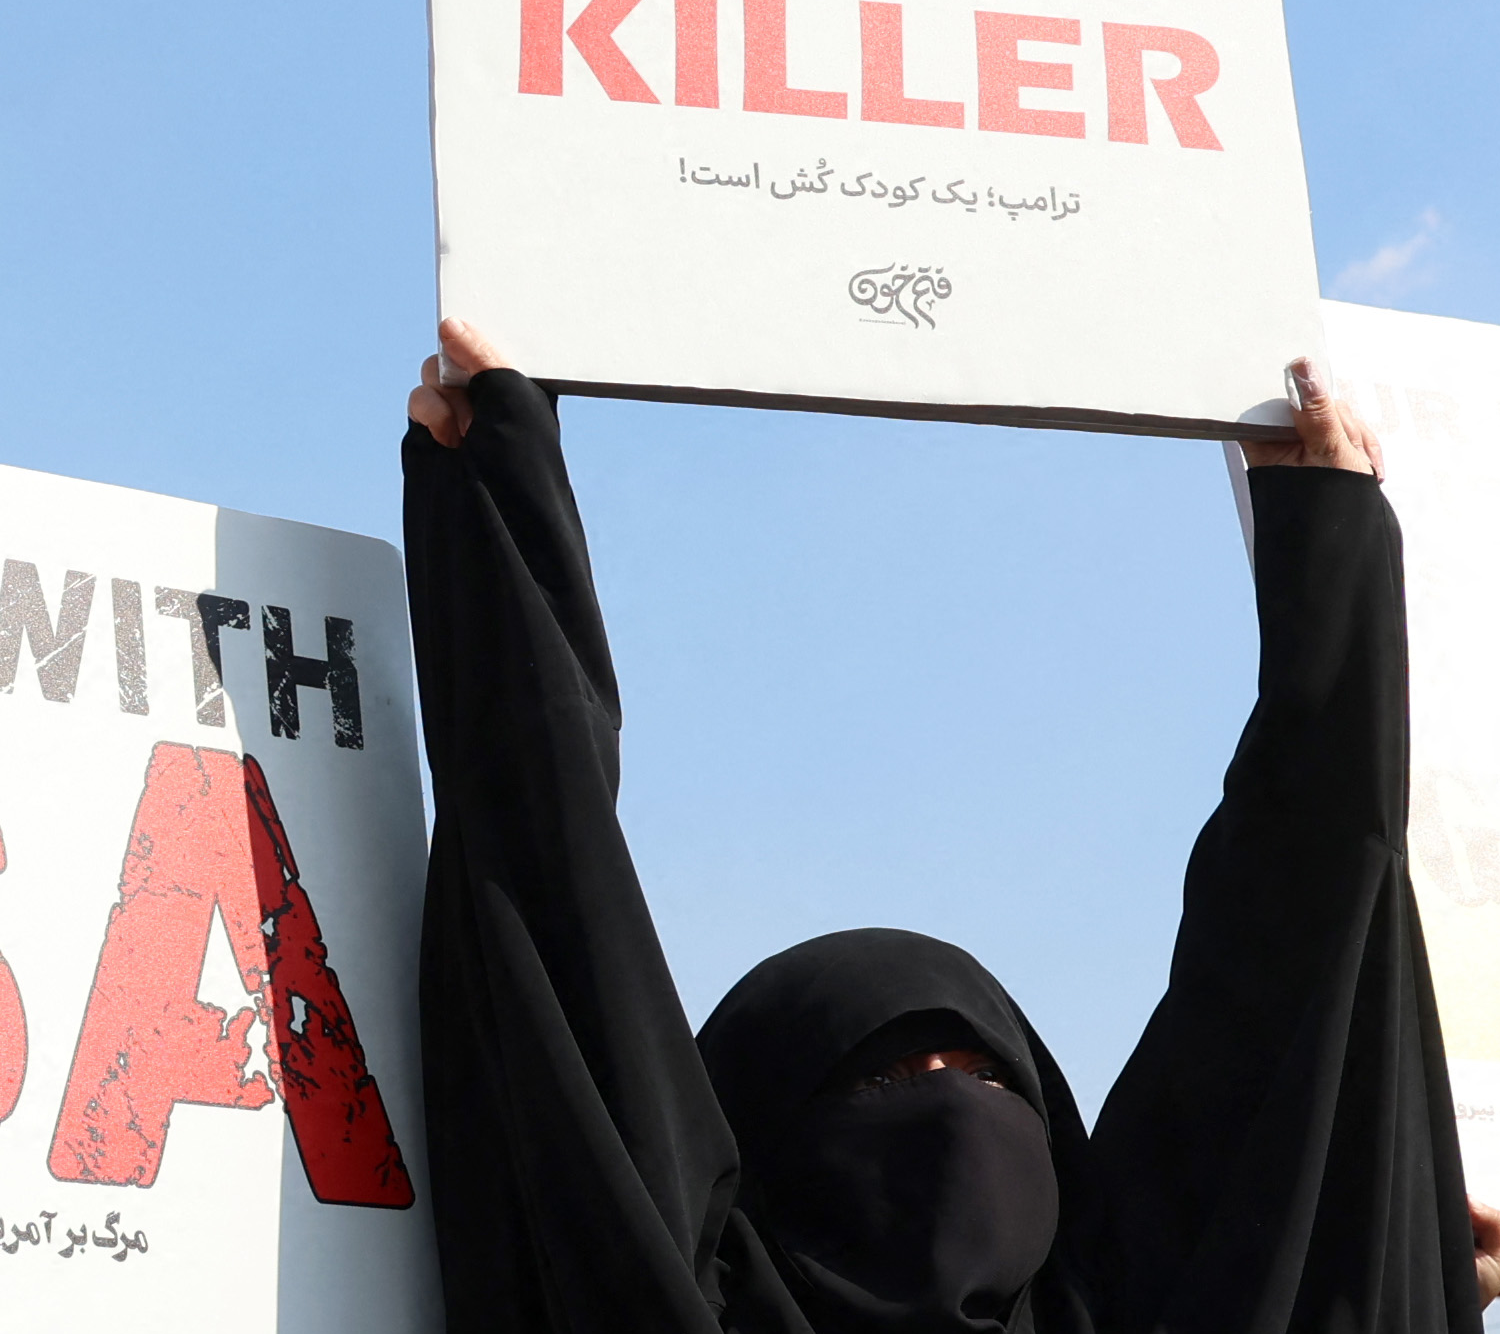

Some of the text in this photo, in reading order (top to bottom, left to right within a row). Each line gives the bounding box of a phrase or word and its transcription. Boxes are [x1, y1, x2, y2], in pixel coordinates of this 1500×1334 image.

[680, 158, 760, 188] است!
[841, 173, 925, 208] کودک
[932, 180, 977, 212] یک
[58, 1224, 88, 1258] بر
[92, 1211, 148, 1262] مرگ
